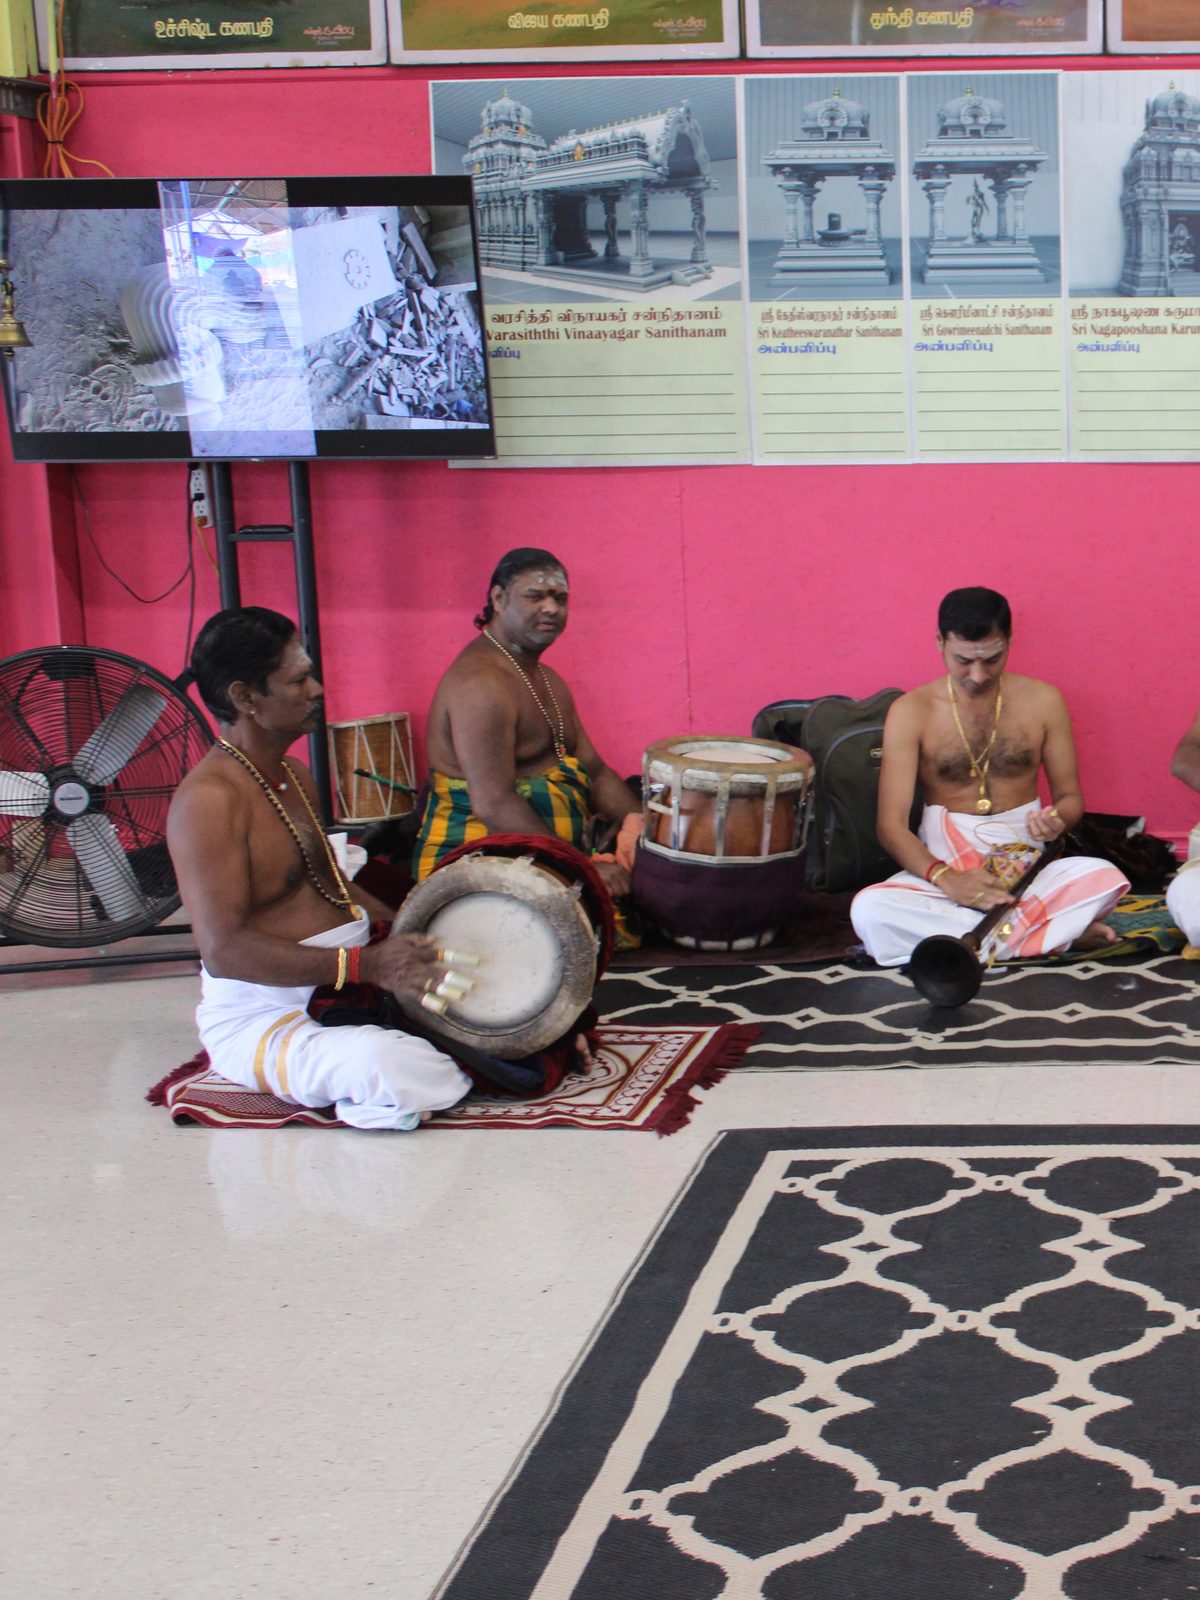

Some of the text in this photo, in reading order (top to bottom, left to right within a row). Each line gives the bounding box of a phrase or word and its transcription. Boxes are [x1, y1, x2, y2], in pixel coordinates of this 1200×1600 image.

[508, 8, 610, 30] விஜய கணபதி
[916, 7, 974, 29] கணபதி
[155, 17, 274, 39] உச்சிஷ்ட கணபதி
[491, 309, 552, 324] வரசித்தி
[558, 308, 627, 324] விநாயகர்
[486, 326, 727, 342] Varasiththi Vinaayagar Sanithanam
[757, 327, 769, 339] Sri
[922, 324, 934, 336] Sri
[1072, 323, 1087, 335] Sri
[1091, 323, 1167, 337] Nagapooshana
[757, 342, 836, 354] அன்பளிப்பு
[914, 339, 993, 352] அன்பளிப்பு
[1076, 340, 1140, 353] அன்பளிப்பு
